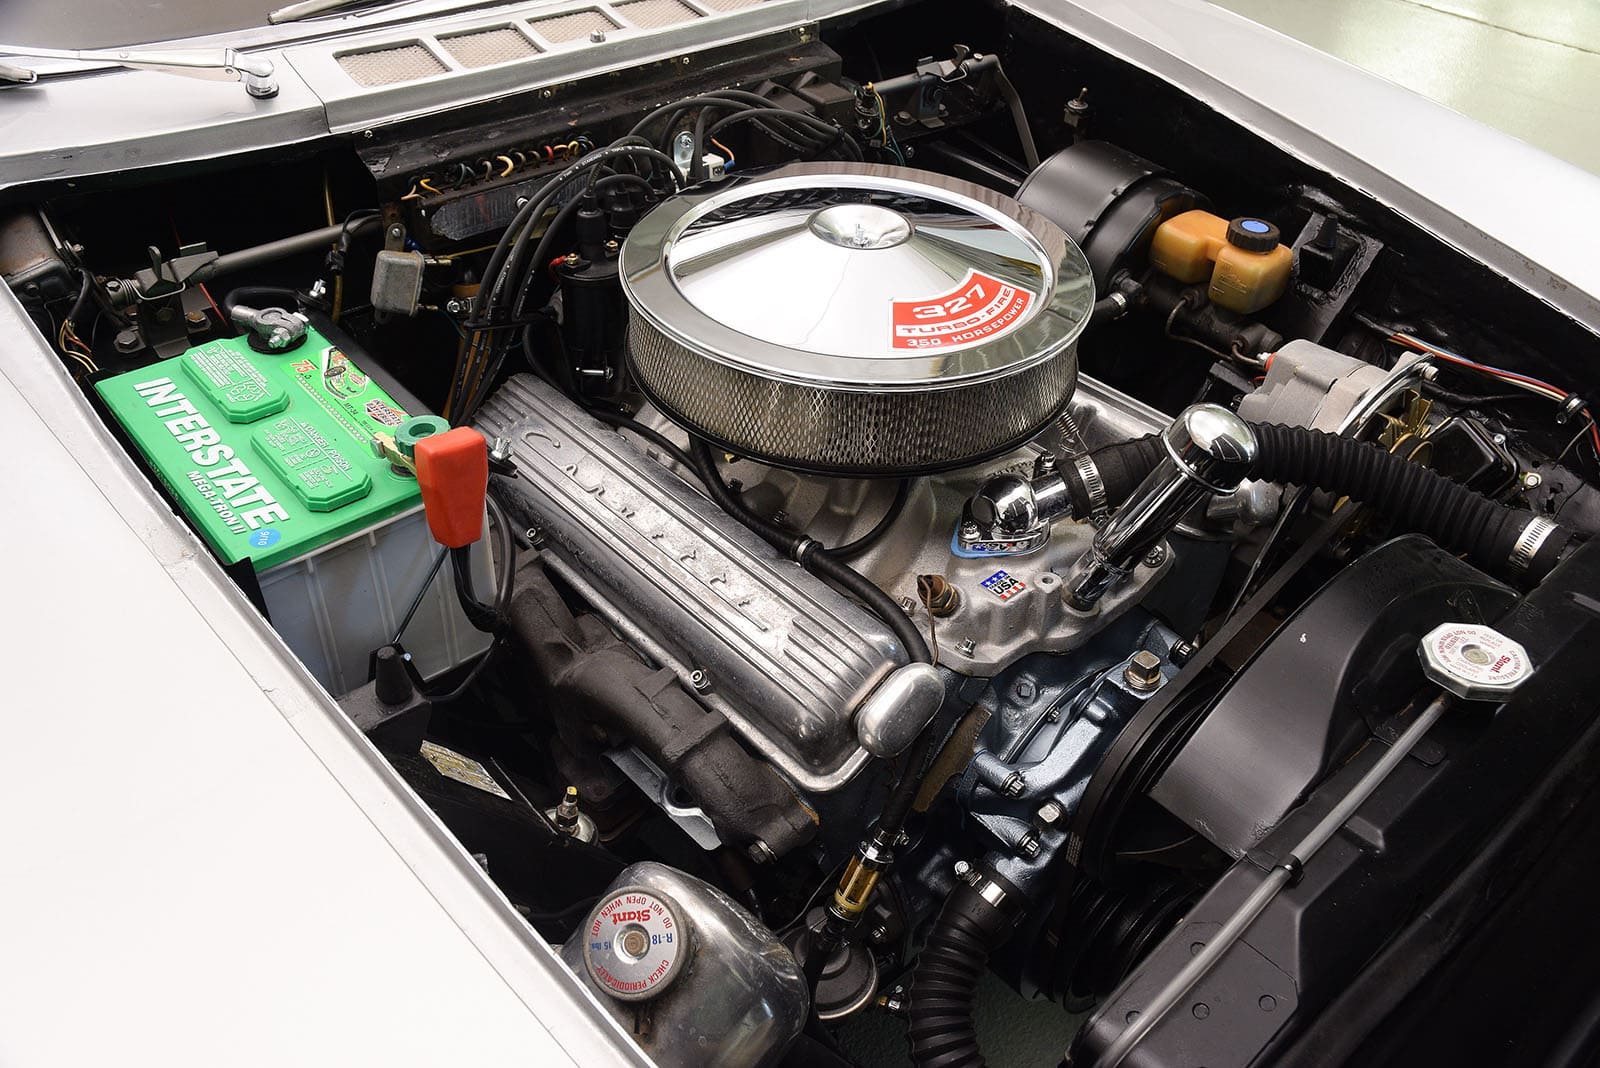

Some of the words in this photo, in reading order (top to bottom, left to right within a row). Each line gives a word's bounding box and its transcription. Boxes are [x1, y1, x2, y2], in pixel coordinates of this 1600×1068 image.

[912, 283, 986, 319] 327
[902, 287, 1012, 334] TURBO-FIRE
[906, 338, 942, 348] 350
[951, 297, 1025, 343] HORSEPOWER
[133, 377, 291, 530] INTERSTATE
[993, 577, 1019, 595] USA
[1490, 655, 1511, 673] Stant
[600, 898, 623, 919] WHEN
[626, 896, 647, 905] OPEN
[649, 902, 665, 916] NOT
[610, 909, 651, 925] Stant
[663, 916, 673, 929] DO
[591, 919, 602, 937] HOT
[651, 933, 673, 945] R-18
[595, 965, 648, 991] PERIODICALLY
[648, 959, 670, 984] CHECK
